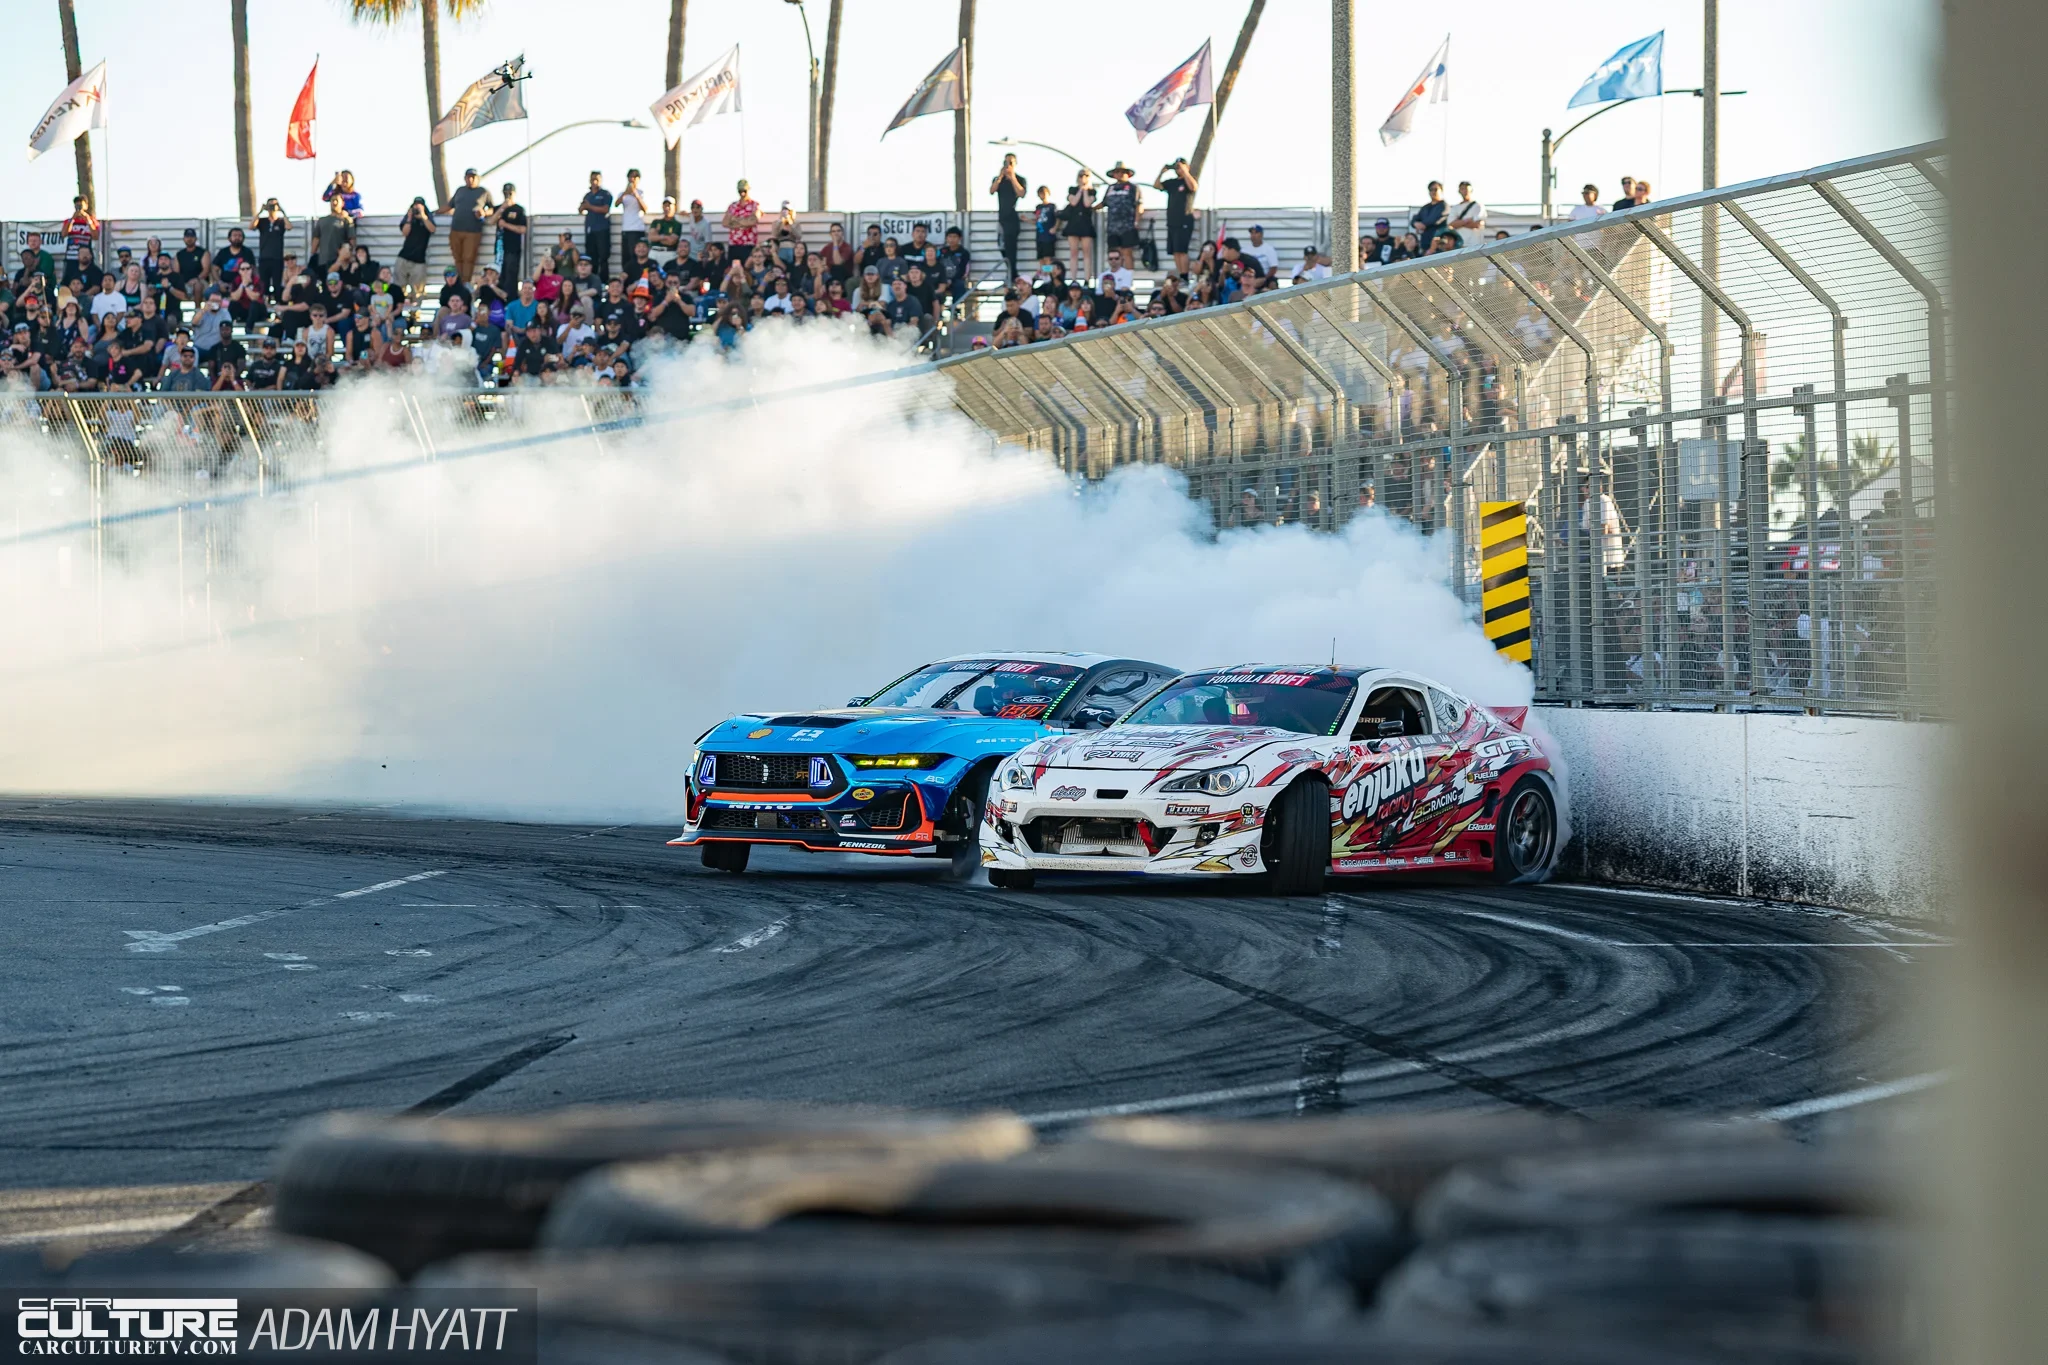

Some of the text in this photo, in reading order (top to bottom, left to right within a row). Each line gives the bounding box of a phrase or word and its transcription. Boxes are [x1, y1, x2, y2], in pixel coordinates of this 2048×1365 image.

[935, 219, 942, 233] 3
[19, 232, 65, 245] STION
[995, 662, 1040, 673] DRIFT
[1206, 674, 1310, 687] FORMULA DRIFT
[1475, 737, 1514, 758] GT
[1474, 770, 1499, 780] FUELAB
[1342, 746, 1426, 820] enjuku
[1377, 791, 1412, 821] racing
[1431, 790, 1459, 811] RACING
[838, 841, 887, 850] PENNZOIL
[1242, 852, 1257, 860] ACL
